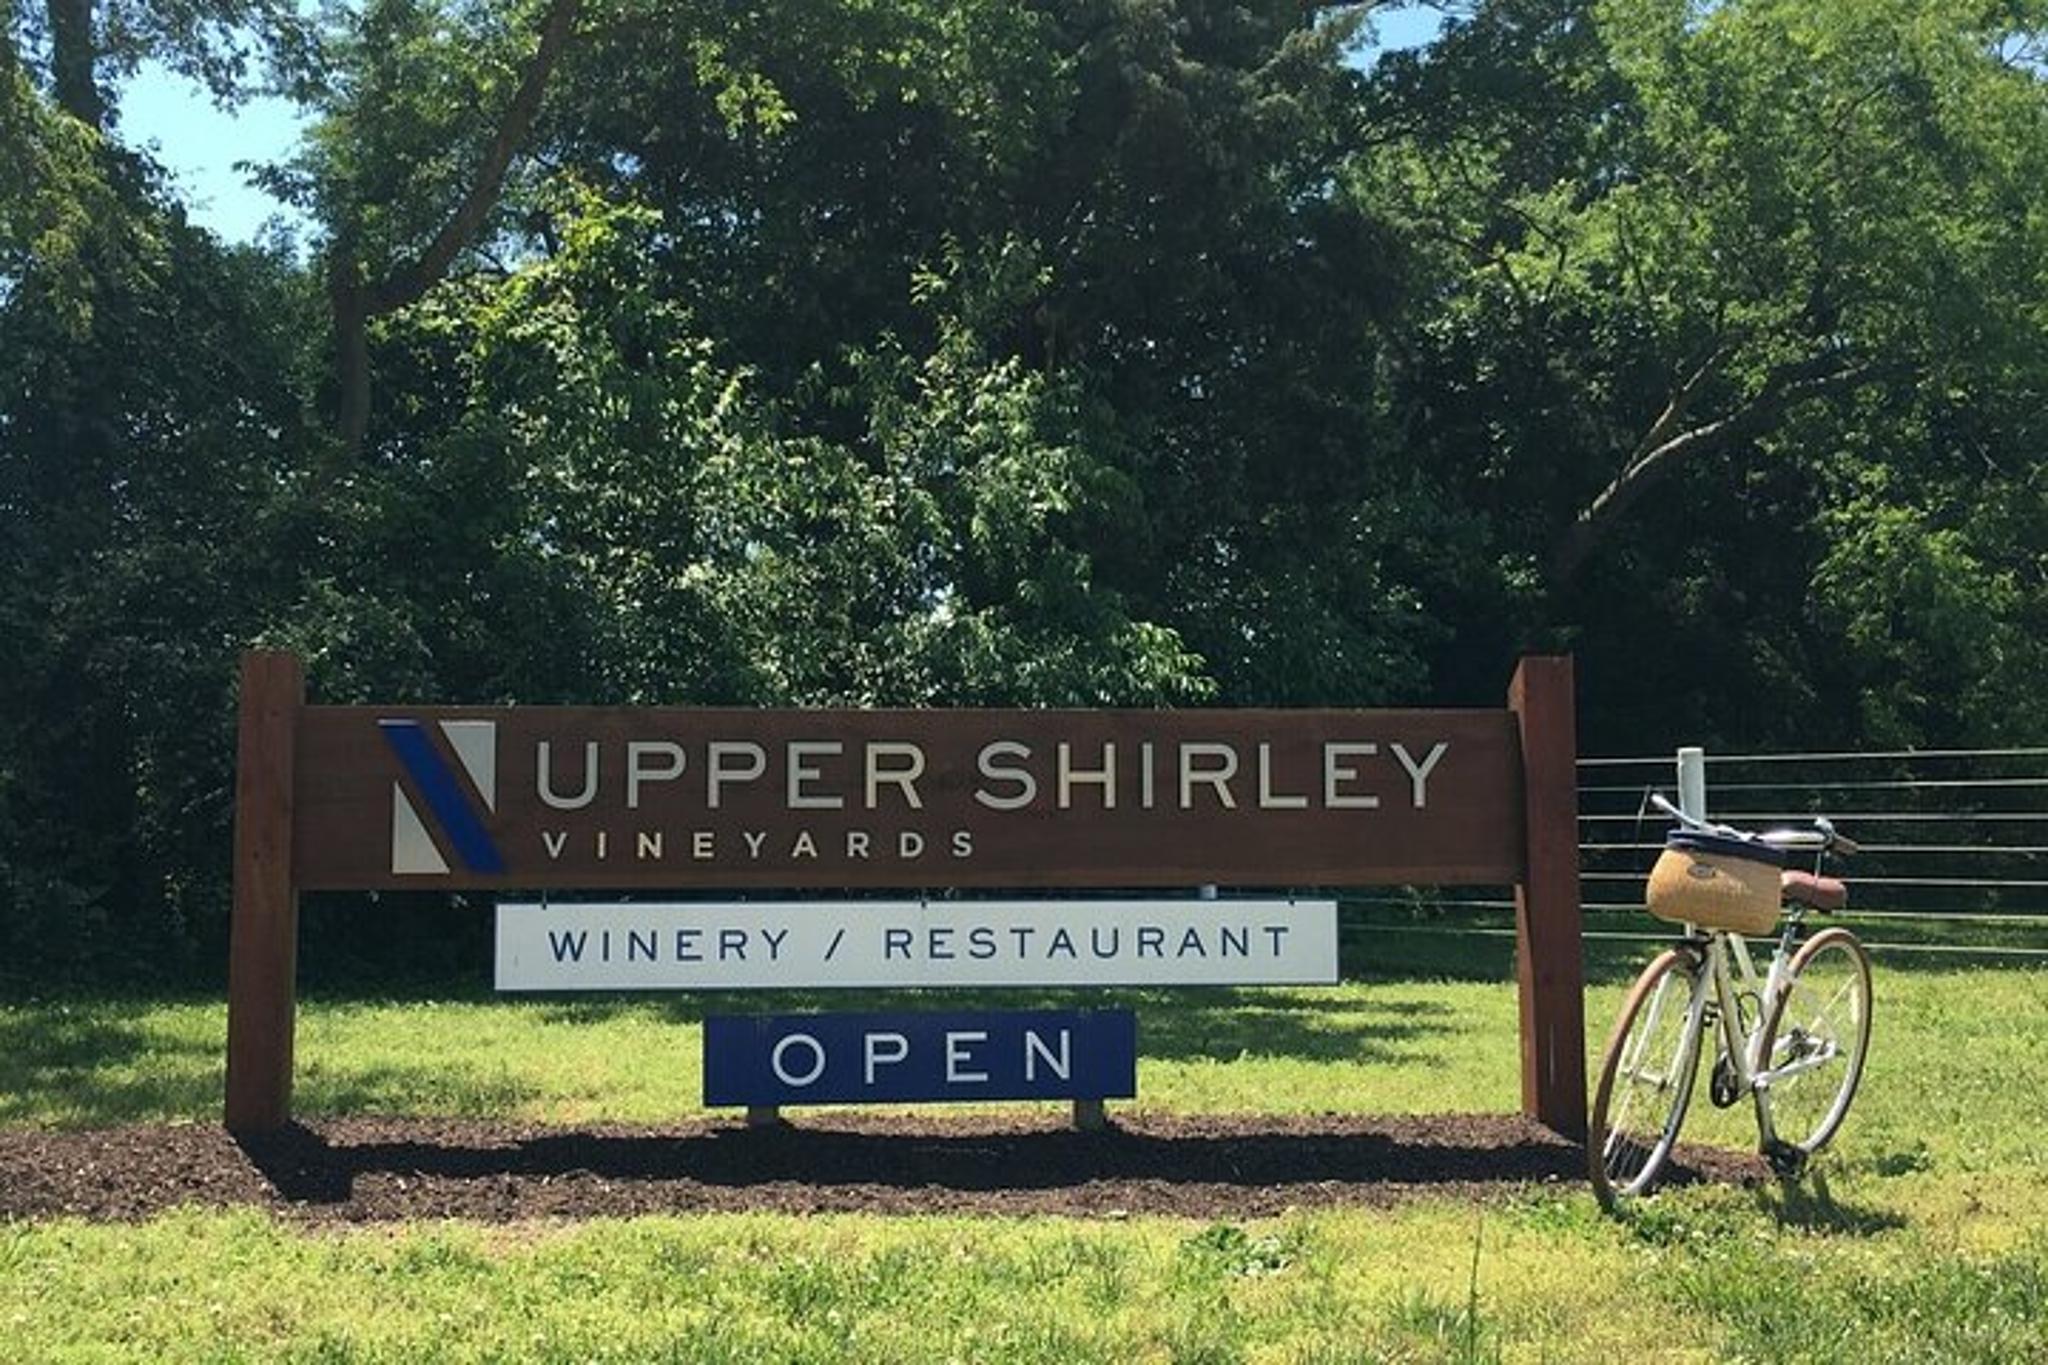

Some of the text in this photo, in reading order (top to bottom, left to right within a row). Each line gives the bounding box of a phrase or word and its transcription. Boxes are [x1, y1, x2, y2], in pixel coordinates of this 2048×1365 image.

[536, 740, 1450, 810] UPPER SHIRLEY
[543, 832, 974, 858] VINEYARDS
[548, 926, 1290, 962] WINERY / RESTAURANT
[772, 1028, 1071, 1087] OPEN
